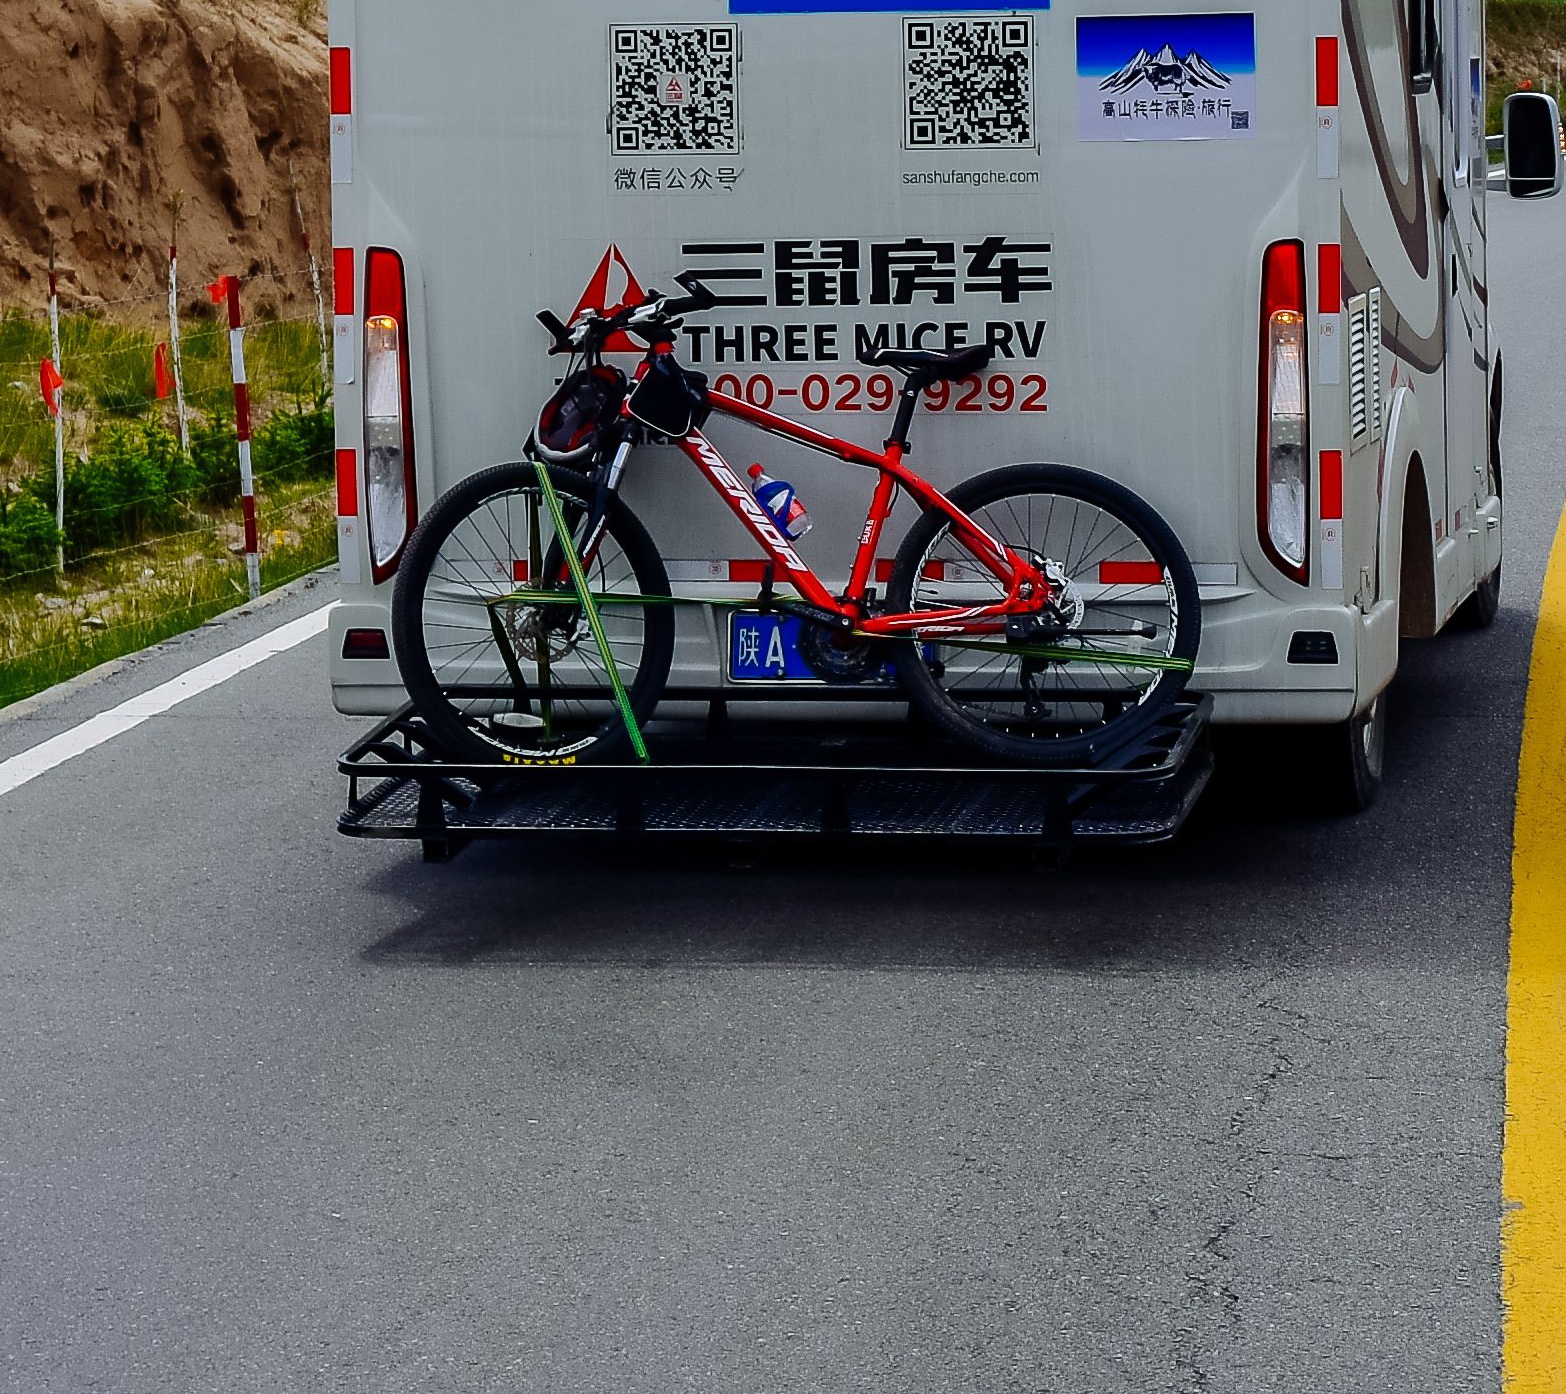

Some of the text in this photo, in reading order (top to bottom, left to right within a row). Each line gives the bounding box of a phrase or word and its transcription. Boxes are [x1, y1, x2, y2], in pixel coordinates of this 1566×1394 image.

[614, 167, 738, 192] 微信公众号
[902, 170, 1039, 186] sanshufangche.com
[682, 237, 1053, 306] 三鼠房车
[683, 320, 1047, 363] THREE MICE RV
[686, 436, 809, 572] MERIDA
